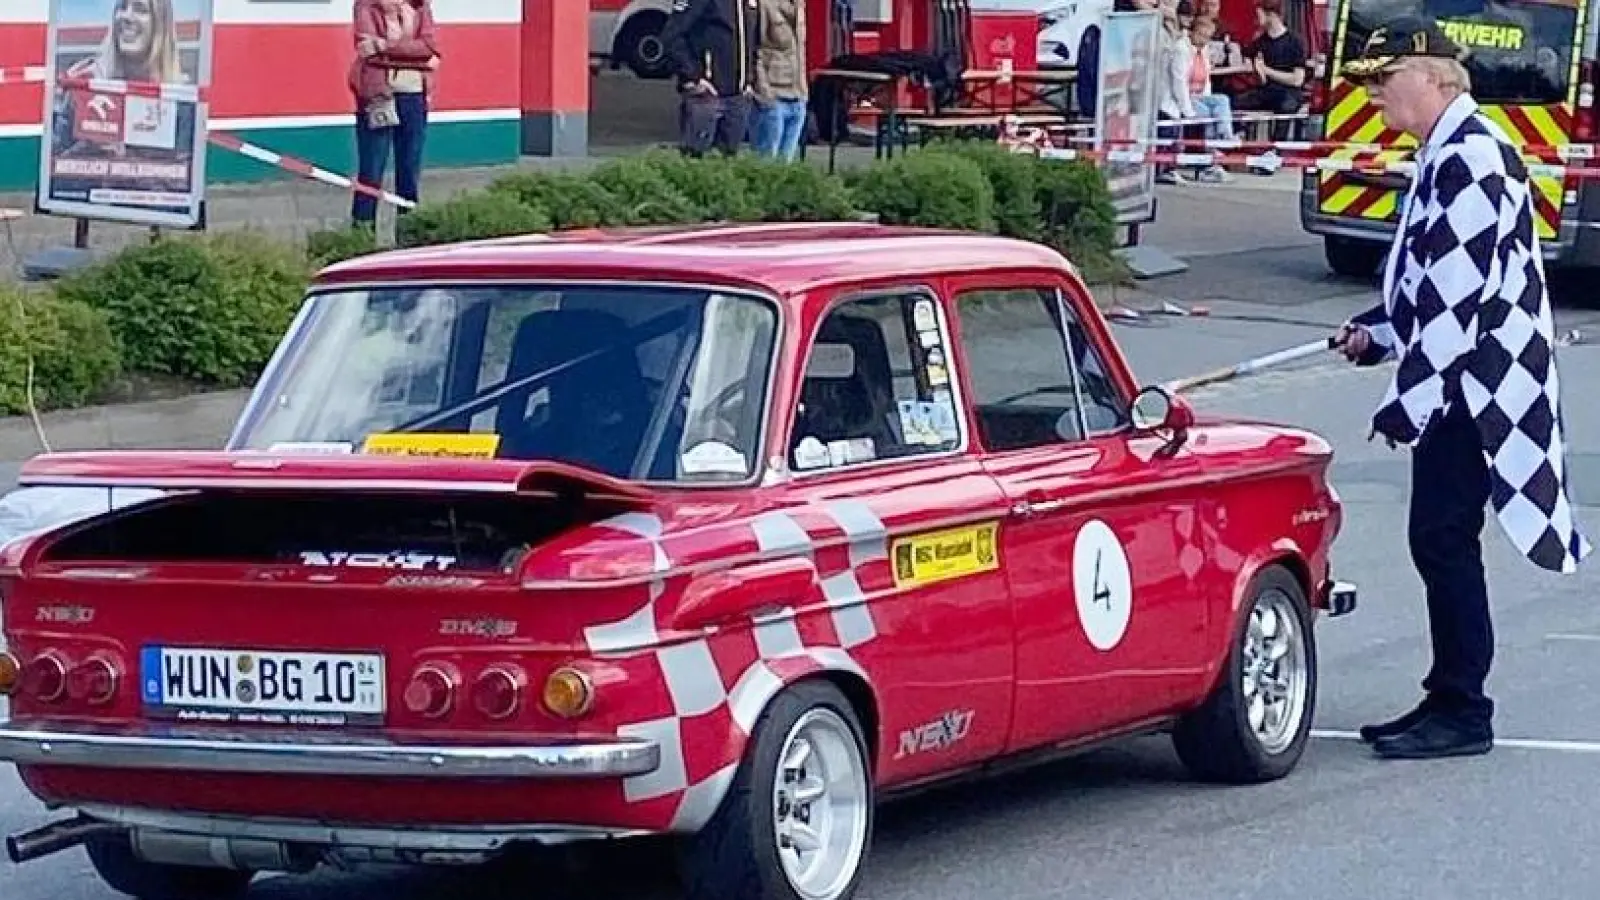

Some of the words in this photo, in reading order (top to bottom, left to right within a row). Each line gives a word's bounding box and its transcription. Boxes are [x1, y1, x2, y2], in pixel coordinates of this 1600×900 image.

[1436, 21, 1523, 49] RWEHR
[1092, 547, 1112, 611] 4
[164, 655, 231, 699] WUN
[259, 658, 303, 701] BG
[313, 660, 356, 703] 10
